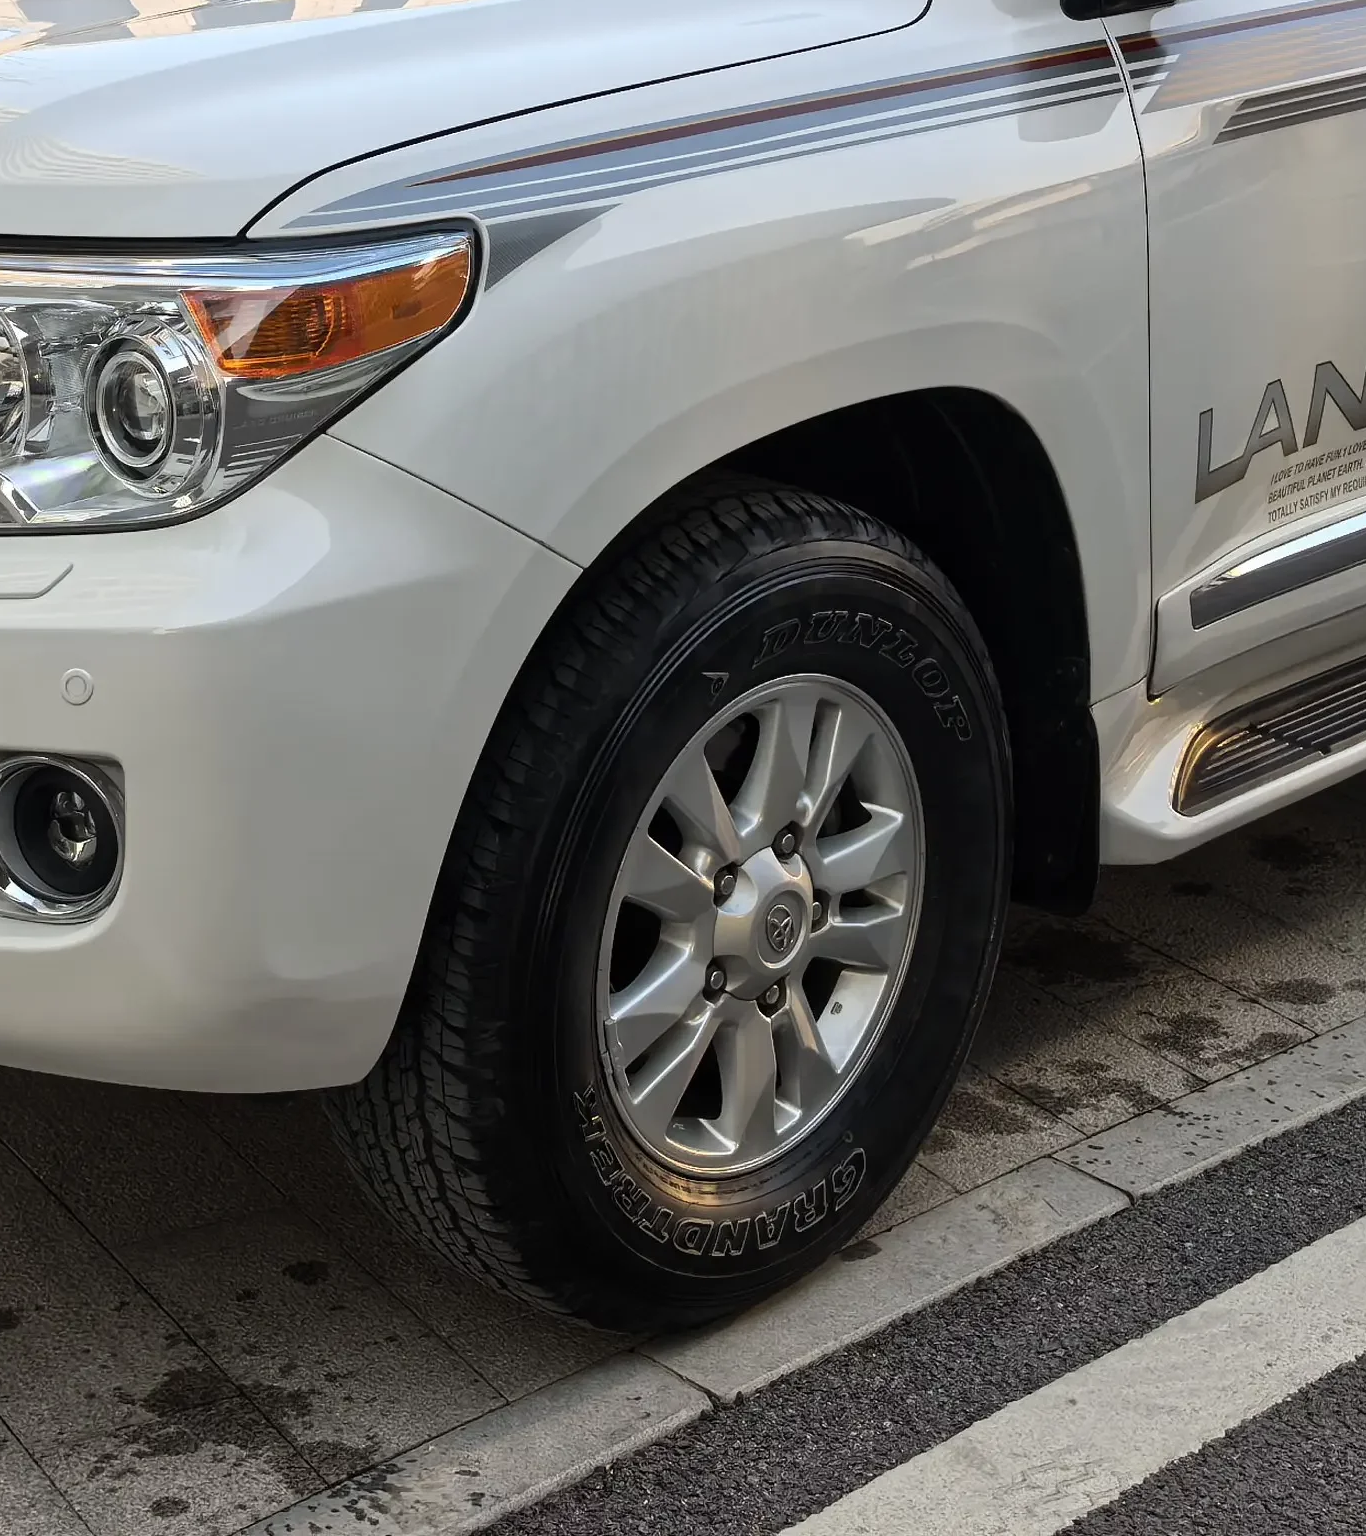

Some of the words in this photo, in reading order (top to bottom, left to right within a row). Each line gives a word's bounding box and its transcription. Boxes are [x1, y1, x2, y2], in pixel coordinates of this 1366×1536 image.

[1267, 484, 1305, 505] BEAUTIFUL
[1306, 468, 1336, 489] PLANET
[1274, 465, 1293, 484] LOVE
[1294, 462, 1303, 475] TO
[1304, 454, 1326, 472] HAVE
[1268, 501, 1298, 524] TOTALLY
[1299, 492, 1329, 511] SATISFY
[1330, 484, 1342, 499] MY
[752, 610, 974, 742] DUNLOP
[572, 1082, 868, 1257] GRANDTREK
